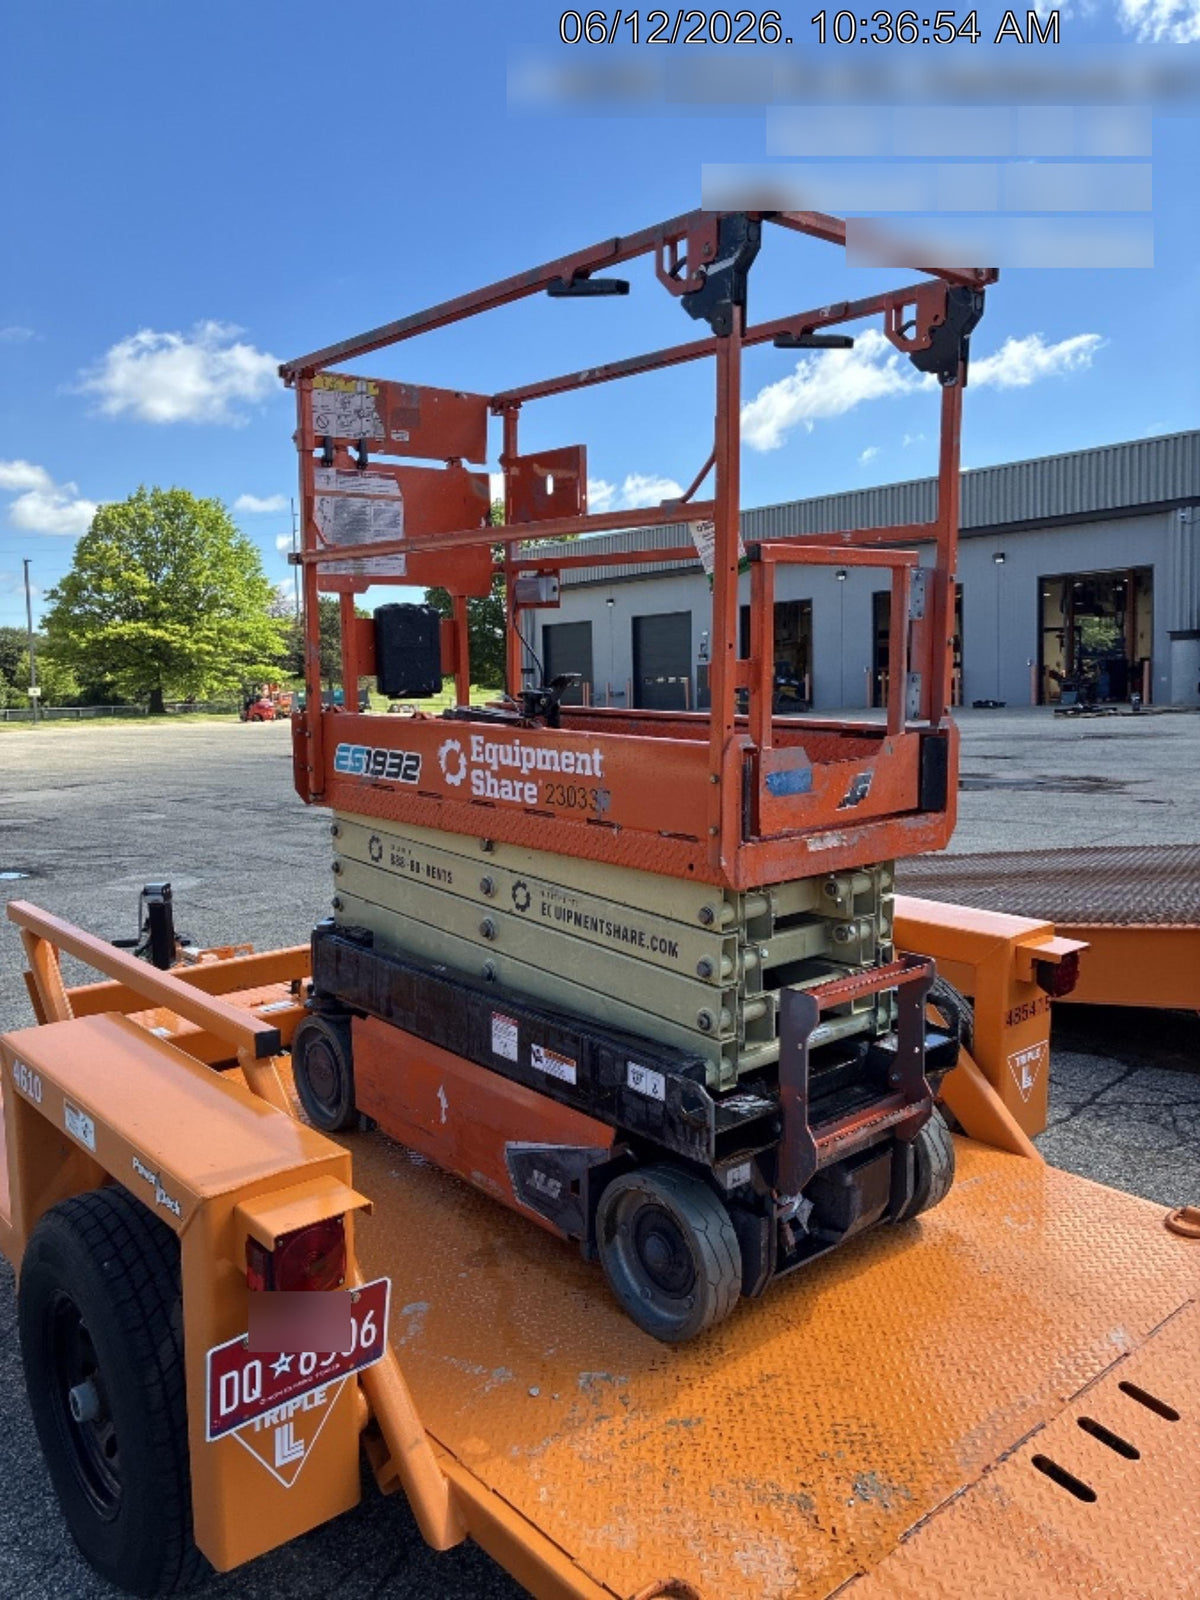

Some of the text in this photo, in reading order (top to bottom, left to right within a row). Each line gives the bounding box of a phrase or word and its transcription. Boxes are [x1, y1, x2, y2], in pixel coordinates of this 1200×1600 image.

[334, 743, 422, 784] ES1932
[470, 734, 604, 778] Equipment
[470, 768, 538, 805] Share
[13, 1059, 43, 1104] 4610
[219, 1360, 263, 1417] DQ
[253, 1385, 328, 1432] TRIPLE
